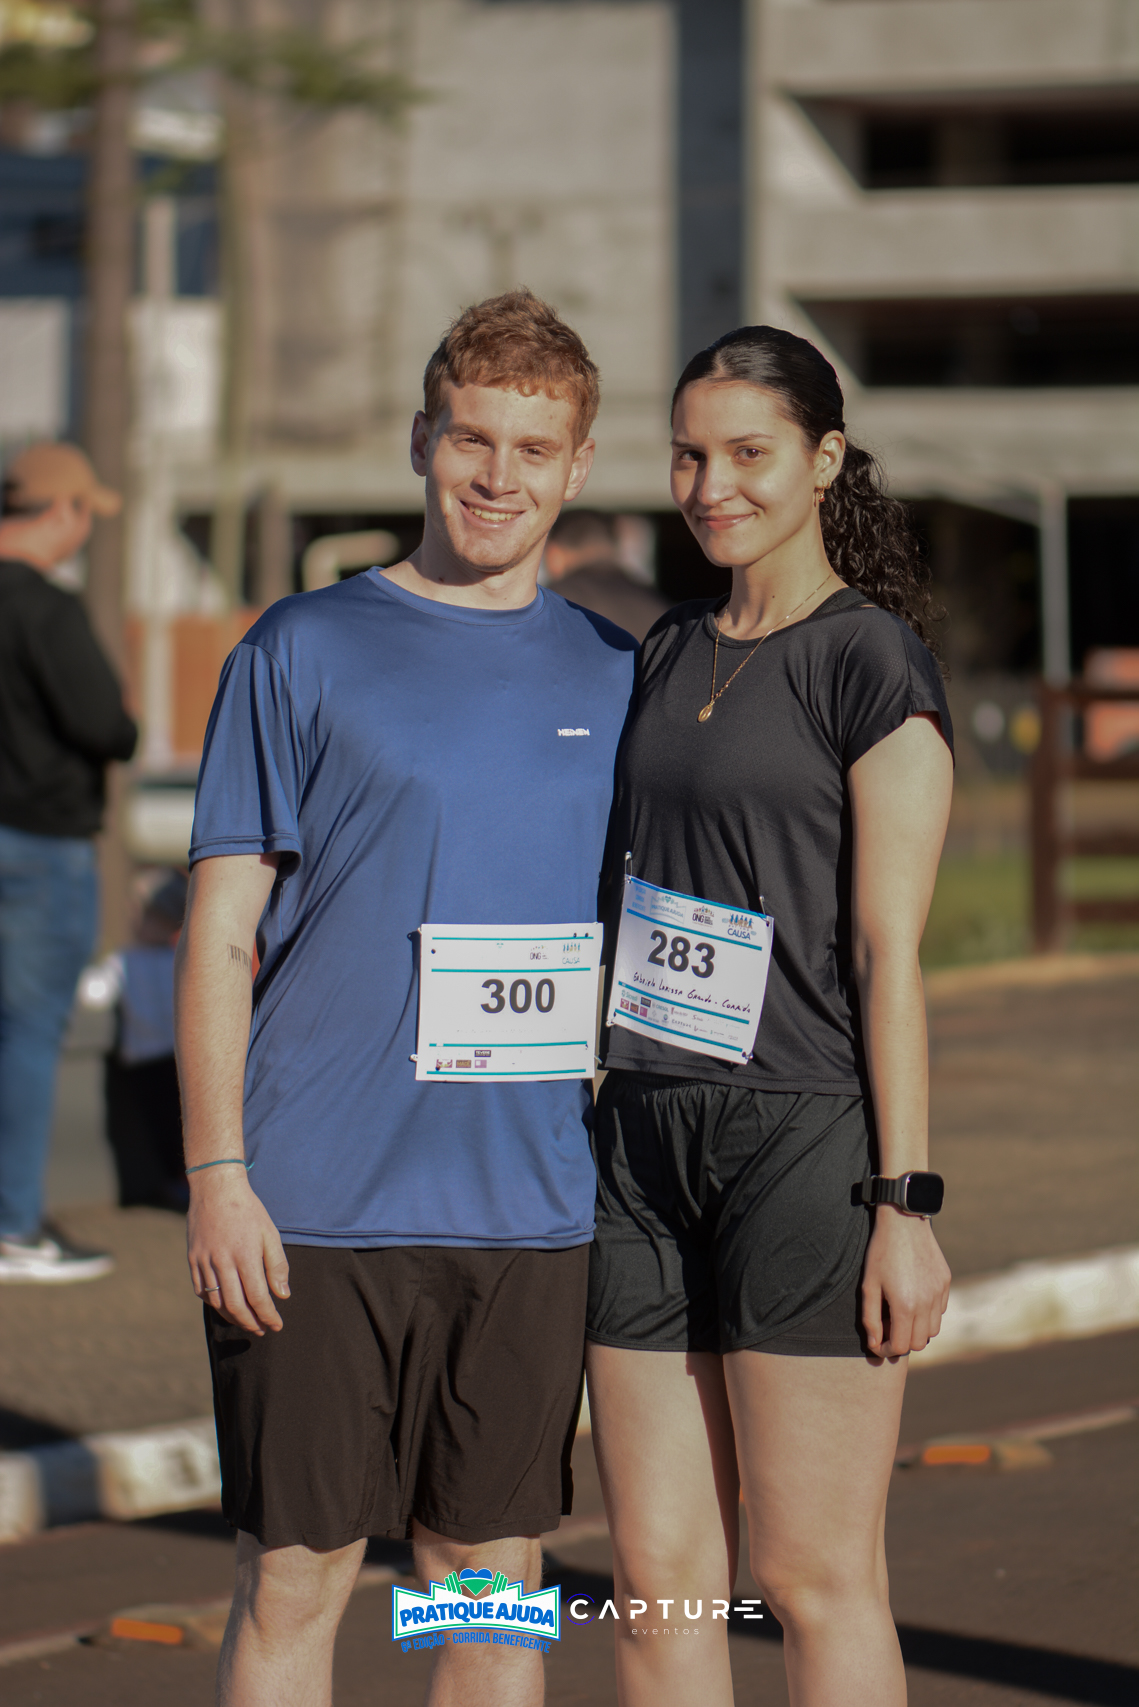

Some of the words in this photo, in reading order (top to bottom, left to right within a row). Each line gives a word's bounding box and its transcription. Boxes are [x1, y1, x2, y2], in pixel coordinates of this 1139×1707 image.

[692, 912, 705, 924] ONG
[727, 927, 751, 941] CAUSA
[647, 929, 715, 979] 283
[480, 978, 556, 1014] 300
